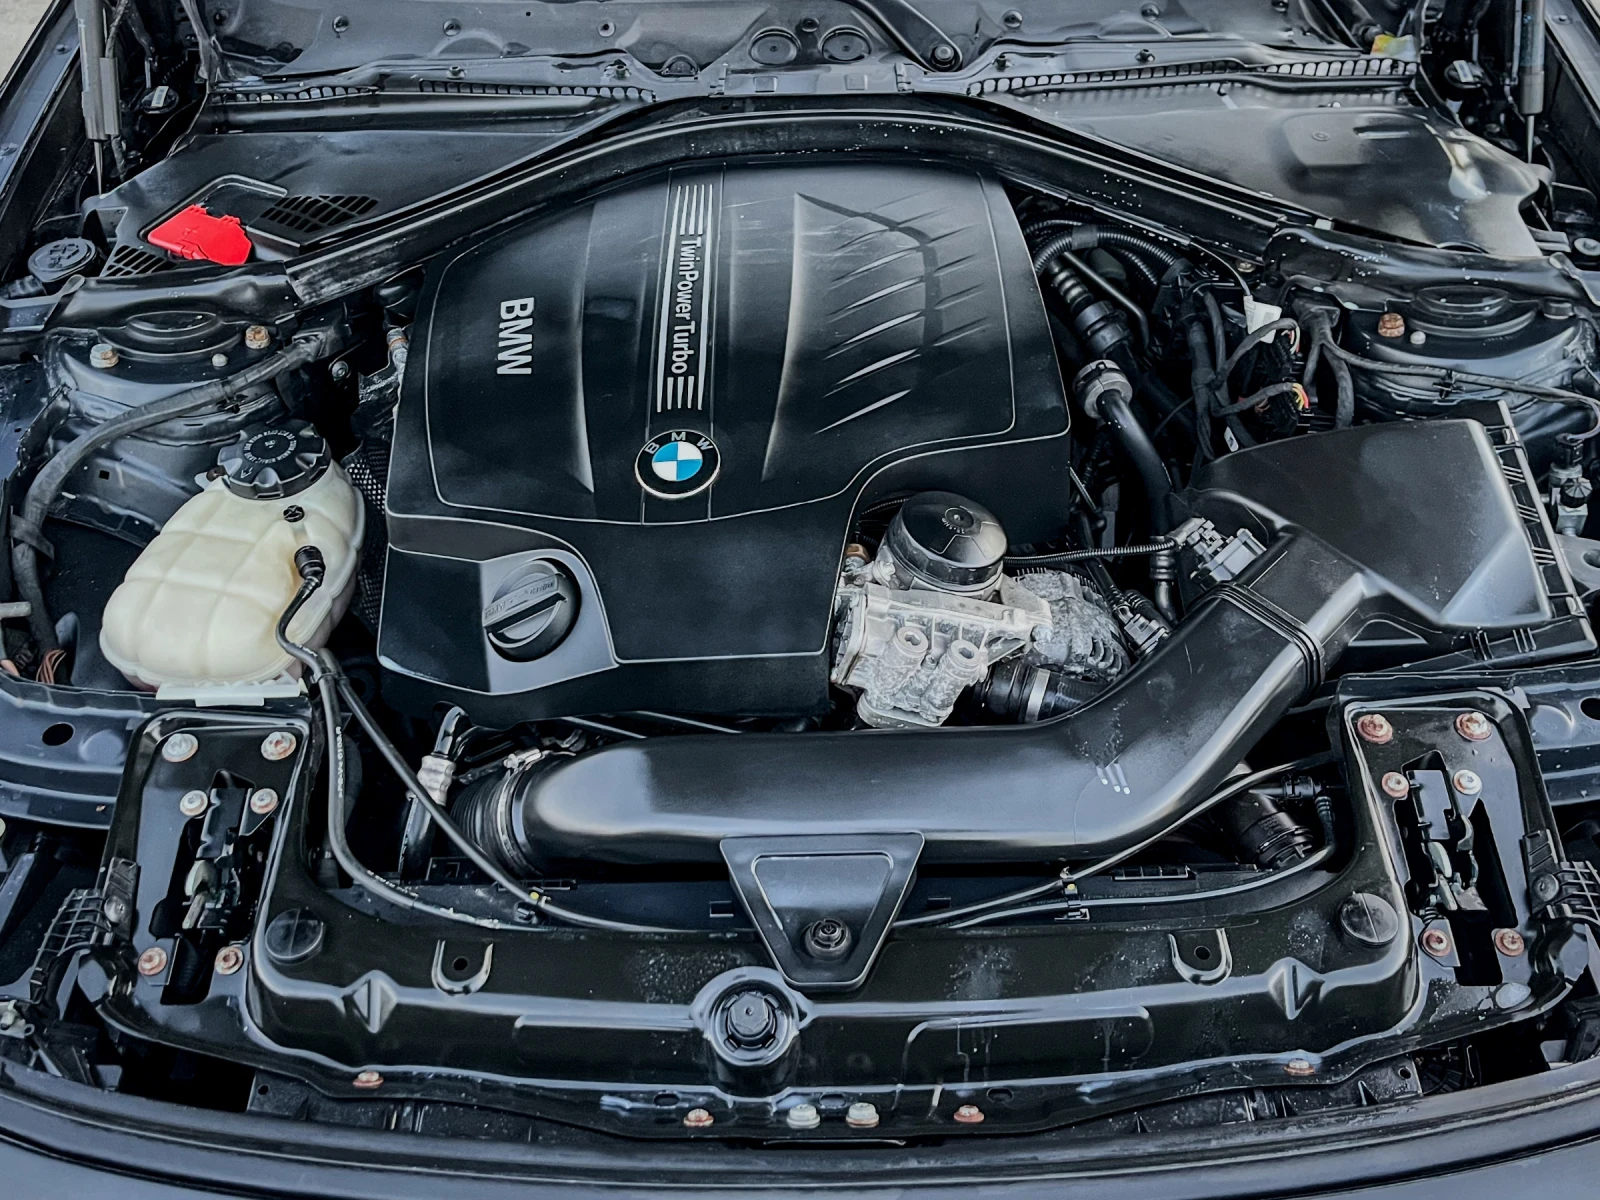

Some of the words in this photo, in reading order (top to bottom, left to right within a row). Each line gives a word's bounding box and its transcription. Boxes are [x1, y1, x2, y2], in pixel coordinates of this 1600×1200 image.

[676, 236, 702, 321] TwinPower
[497, 296, 535, 375] BMW
[671, 321, 696, 374] Turbo
[645, 431, 713, 454] BMW
